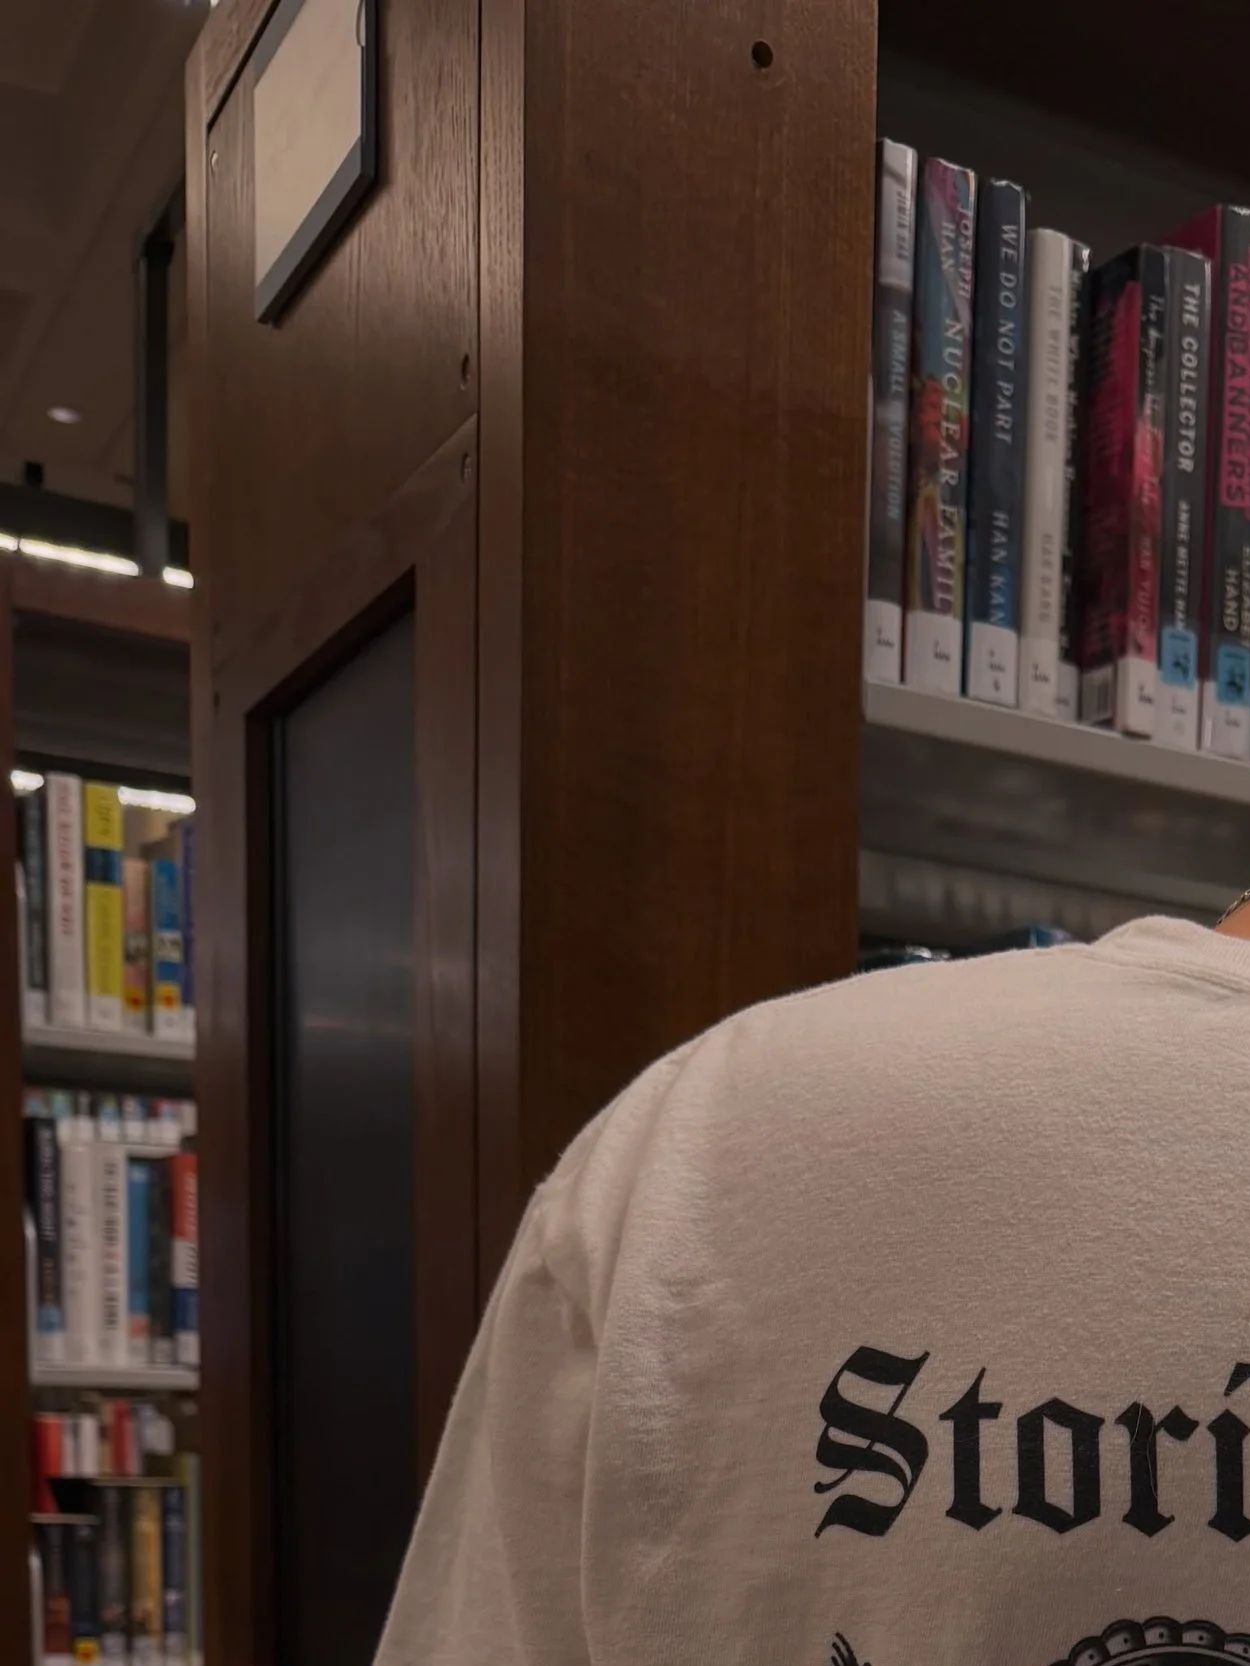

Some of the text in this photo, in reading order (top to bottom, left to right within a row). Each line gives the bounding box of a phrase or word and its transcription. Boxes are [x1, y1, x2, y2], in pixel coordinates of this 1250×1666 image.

[941, 221, 957, 273] HAN
[957, 202, 972, 300] JOSEPH
[891, 309, 907, 324] A
[994, 223, 1019, 445] WE DO NOT PART
[889, 329, 907, 395] SMALL
[1176, 282, 1201, 475] THE COLLECTOR
[1226, 264, 1249, 502] AND BANNERS
[940, 318, 963, 486] NUCLEAR
[990, 510, 1010, 563] HAN
[1177, 500, 1191, 543] ANNE
[935, 503, 957, 617] FAMIL
[1175, 546, 1189, 594] METTE
[1223, 568, 1241, 632] HAND
